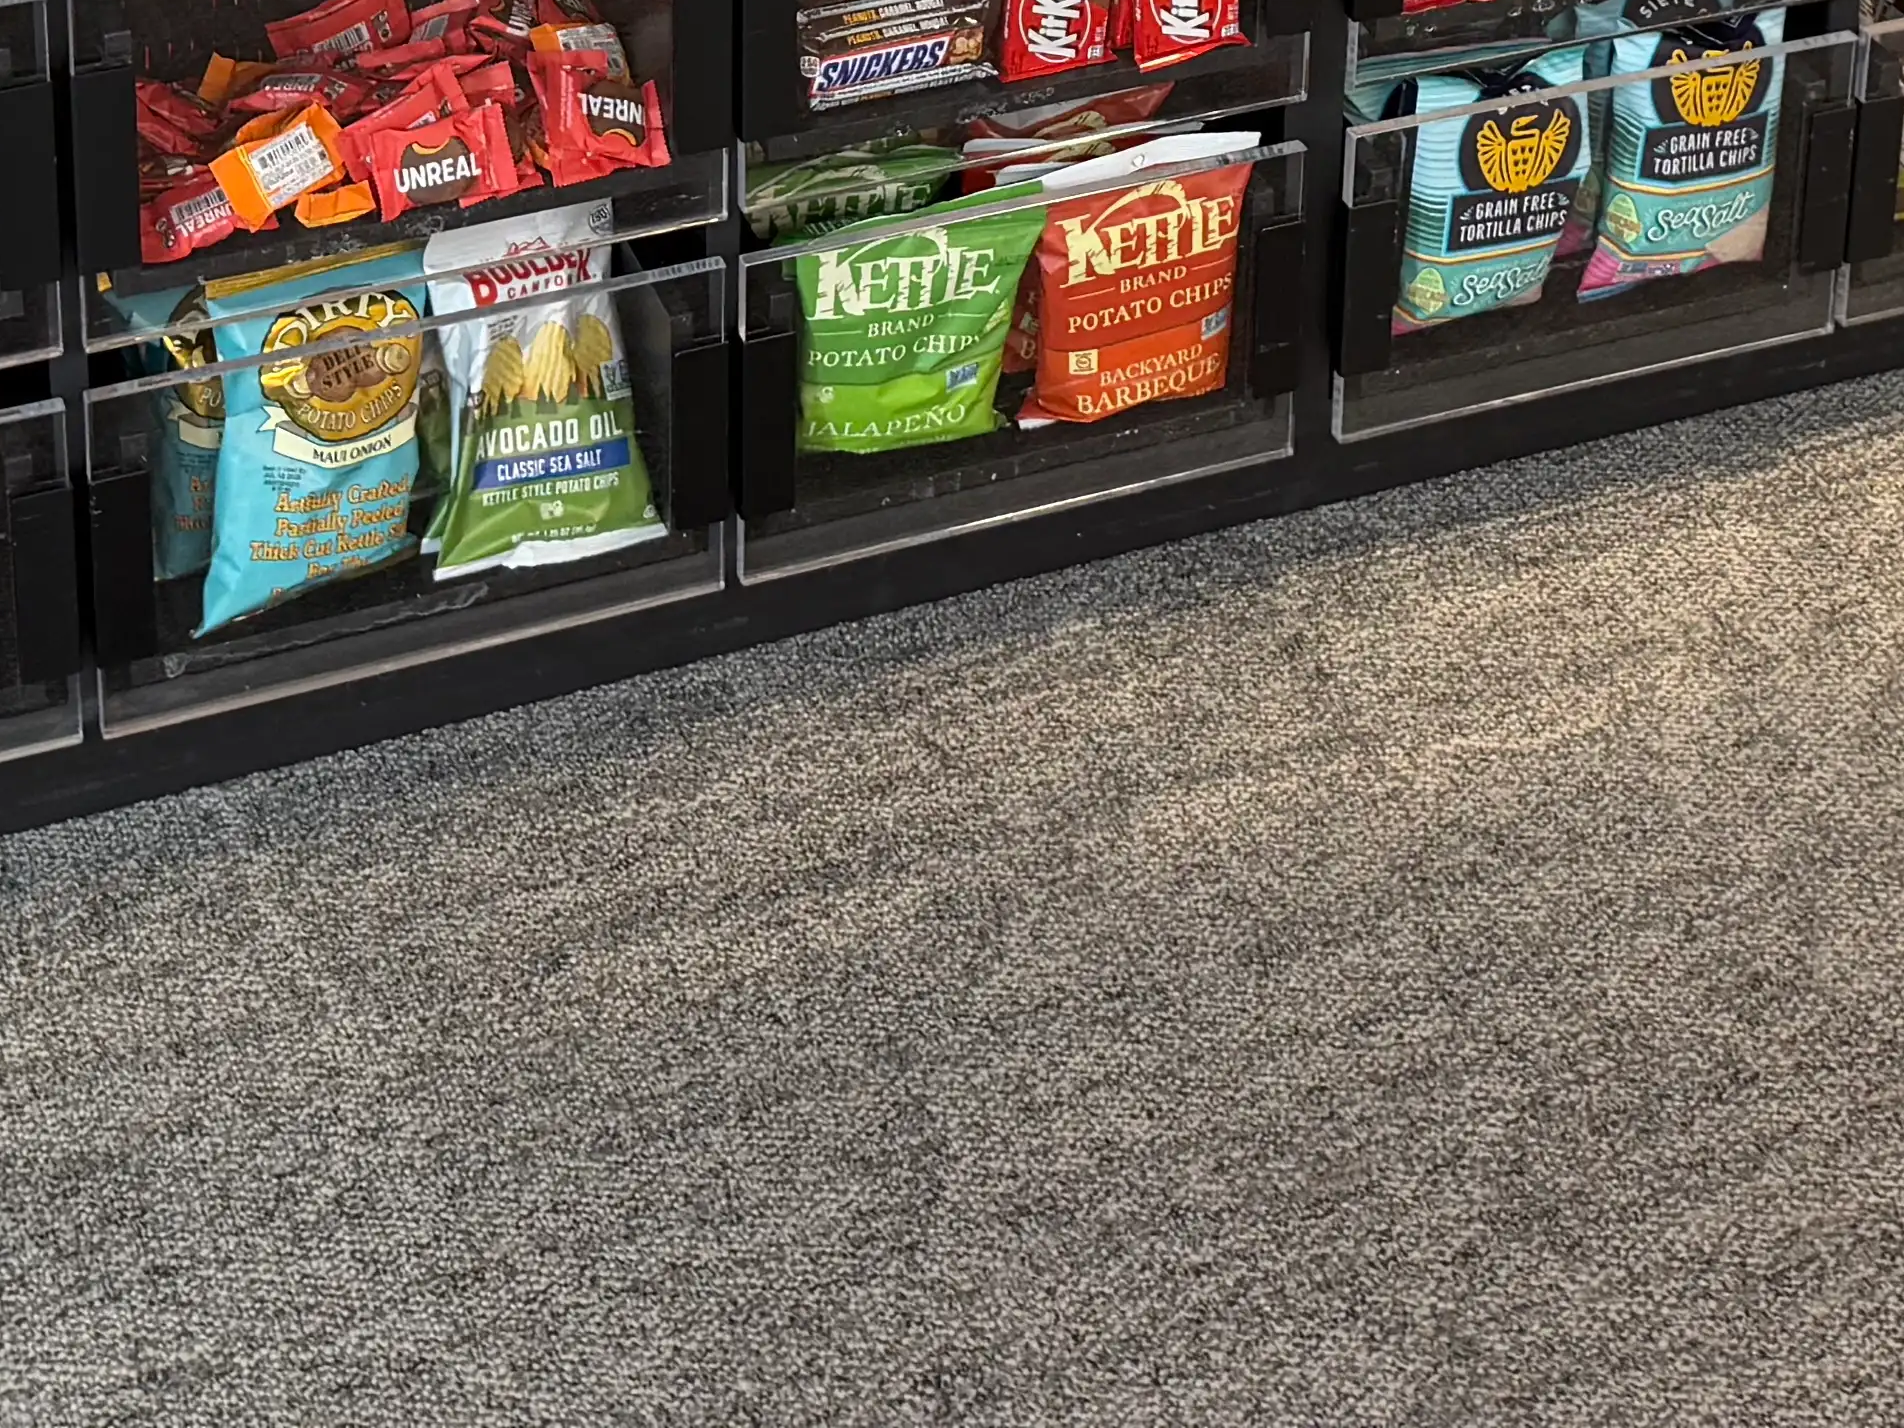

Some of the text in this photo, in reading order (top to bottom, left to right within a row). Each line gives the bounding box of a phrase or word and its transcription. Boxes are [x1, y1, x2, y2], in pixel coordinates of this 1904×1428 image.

[817, 40, 945, 91] SNICKERS
[1669, 126, 1749, 155] GRAIN FREE
[394, 152, 484, 193] UNREAL
[1652, 143, 1757, 177] TORTILLA CHIPS
[1474, 191, 1556, 222] GRAIN FREE
[1057, 179, 1241, 289] KETTLE
[1459, 209, 1567, 244] TORTILLA CHIPS
[812, 225, 1002, 323] KETTLE
[1119, 265, 1188, 295] BRAND
[1067, 272, 1234, 335] POTATO CHIPS
[866, 314, 935, 339] BRAND
[322, 354, 375, 389] STYLE
[807, 345, 907, 368] POTATO
[1099, 344, 1203, 389] BACKYARD
[1076, 352, 1221, 417] BARBEQUE
[299, 382, 403, 432] POTATO CHIPS
[803, 402, 967, 439] JALAPEÑO
[475, 411, 623, 461] AVOCADO OIL
[496, 448, 602, 482] CLASSIC SEA SALT
[482, 475, 620, 507] KETTLE STYLE POTATO CHIPS
[250, 527, 384, 562] Thick Cut Kettle
